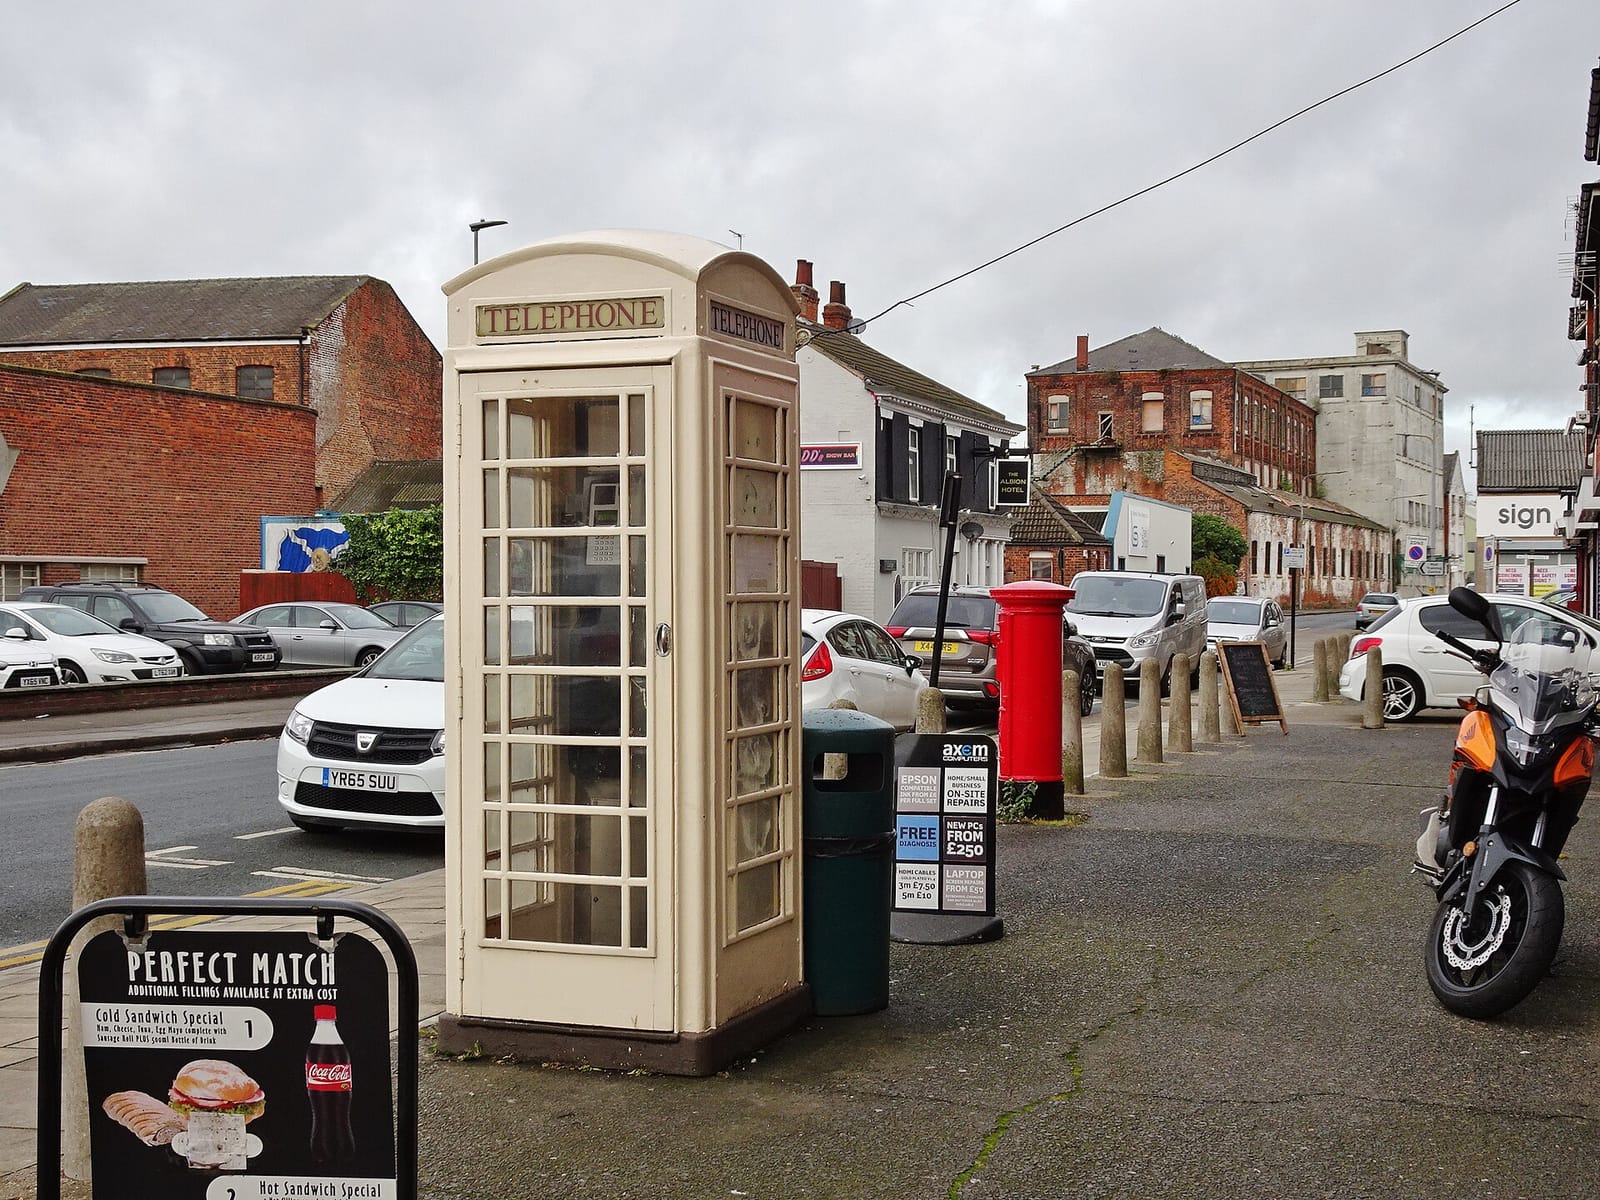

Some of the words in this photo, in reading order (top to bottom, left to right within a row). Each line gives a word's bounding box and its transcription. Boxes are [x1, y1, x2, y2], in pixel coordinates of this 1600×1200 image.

[484, 300, 658, 333] TELEPHONE
[711, 305, 781, 347] TELEPHONE
[1498, 504, 1551, 529] sign
[331, 771, 365, 787] YR65
[368, 775, 397, 790] SUU
[901, 775, 937, 785] EPSON
[947, 790, 985, 798] ON-SITE
[947, 799, 986, 807] REPAIRS
[946, 822, 967, 830] NEW
[967, 822, 984, 830] PCs
[900, 827, 937, 840] FREE
[946, 830, 984, 842] FROM
[946, 842, 984, 858] £250
[945, 869, 984, 879] LAPTOP
[898, 882, 911, 890] 3m
[913, 881, 936, 890] £7.50
[945, 885, 968, 893] FROM
[969, 886, 984, 894] £50
[127, 951, 237, 984] PERFECT
[252, 952, 336, 986] MATCH
[128, 984, 179, 997] ADDITIONAL
[182, 985, 220, 998] FILLINGS
[223, 986, 270, 999] AVAILABLE
[272, 987, 284, 999] AT
[287, 988, 314, 1000] EXTRA
[317, 988, 338, 1000] COST
[96, 1008, 120, 1023] Cold
[125, 1009, 178, 1024] Sandwich
[183, 1010, 224, 1027] Special
[156, 1025, 166, 1035] Egg
[168, 1026, 183, 1035] Mayo
[185, 1026, 211, 1036] complete
[213, 1027, 227, 1035] with
[244, 1019, 253, 1039] 1
[97, 1034, 120, 1043] Sausage
[122, 1034, 134, 1042] Roll
[136, 1035, 150, 1043] PLUS
[171, 1036, 190, 1044] Bottle
[192, 1036, 198, 1044] of
[200, 1037, 216, 1045] Drink
[309, 1063, 350, 1081] Coca-Cola
[259, 1180, 279, 1195] Hot
[284, 1181, 336, 1197] Sandwich
[341, 1183, 381, 1200] Special
